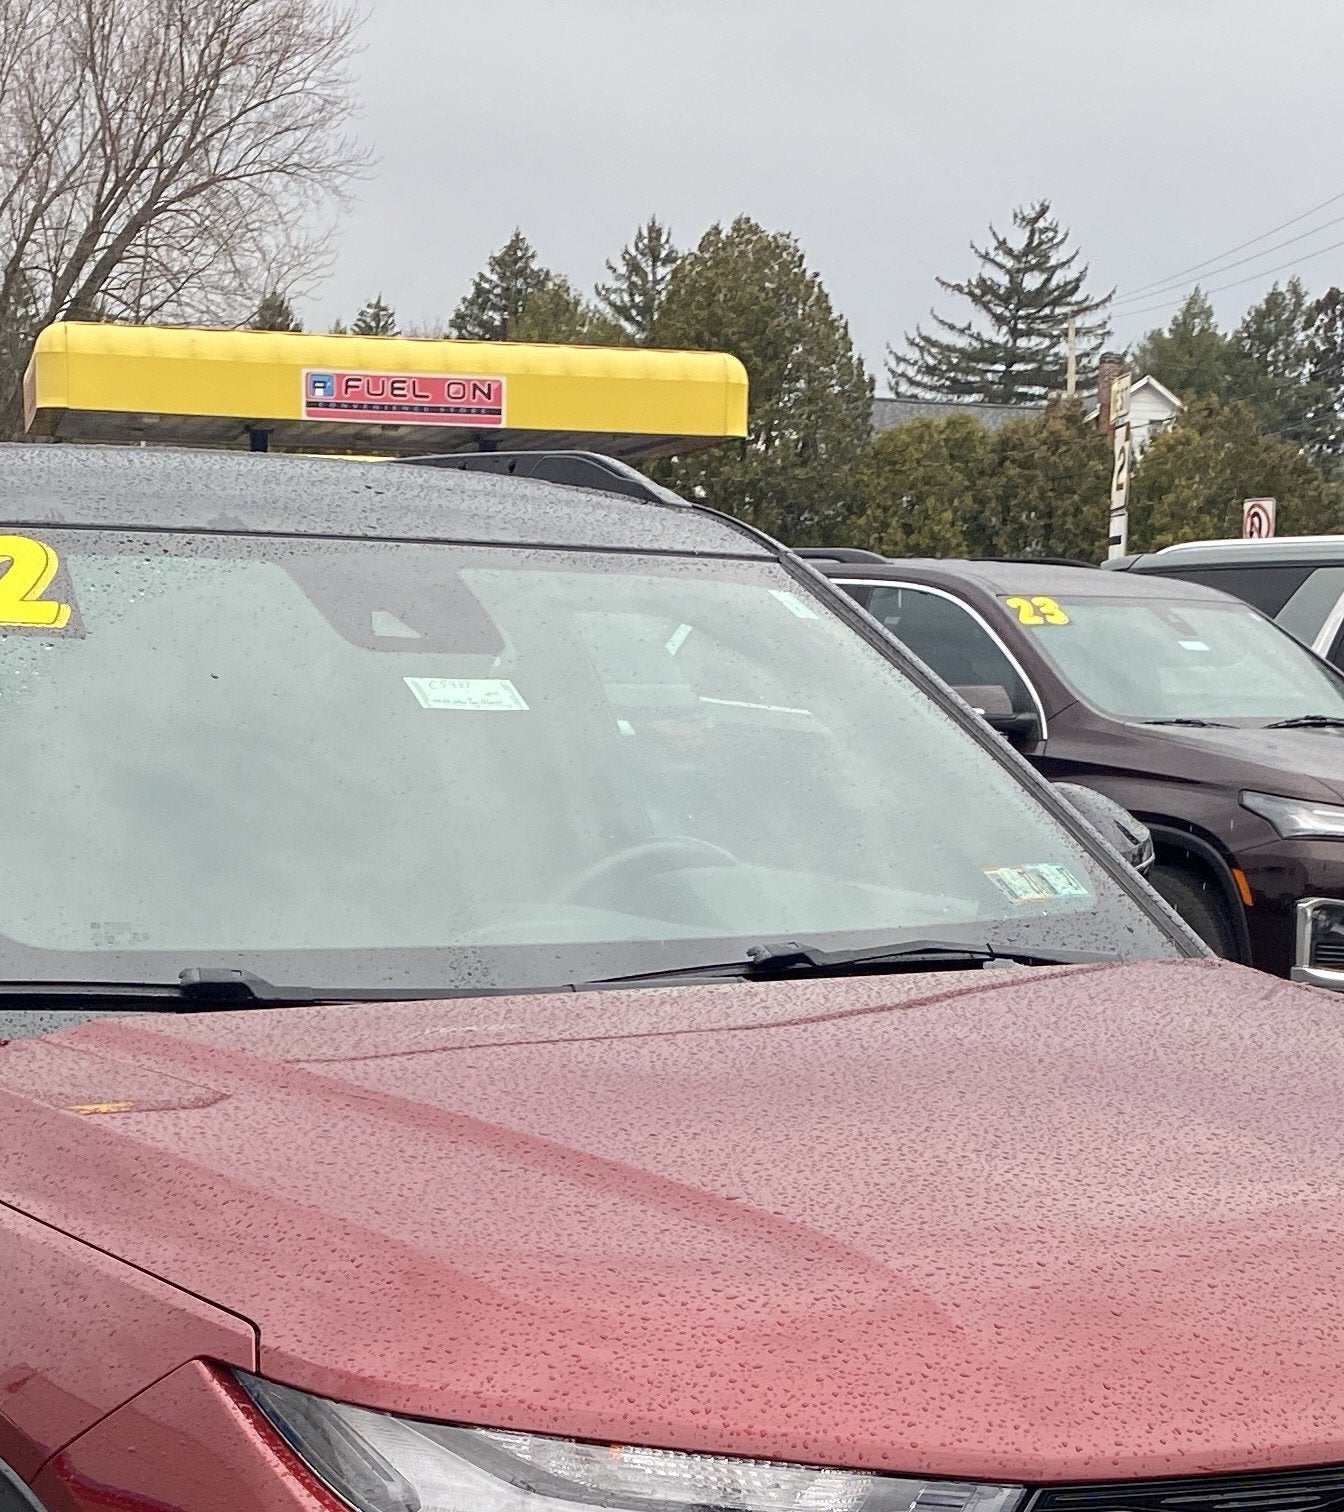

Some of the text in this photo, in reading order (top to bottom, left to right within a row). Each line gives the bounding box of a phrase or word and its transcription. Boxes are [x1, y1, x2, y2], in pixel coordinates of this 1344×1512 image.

[345, 377, 492, 401] FUEL ON
[1006, 596, 1069, 625] 23
